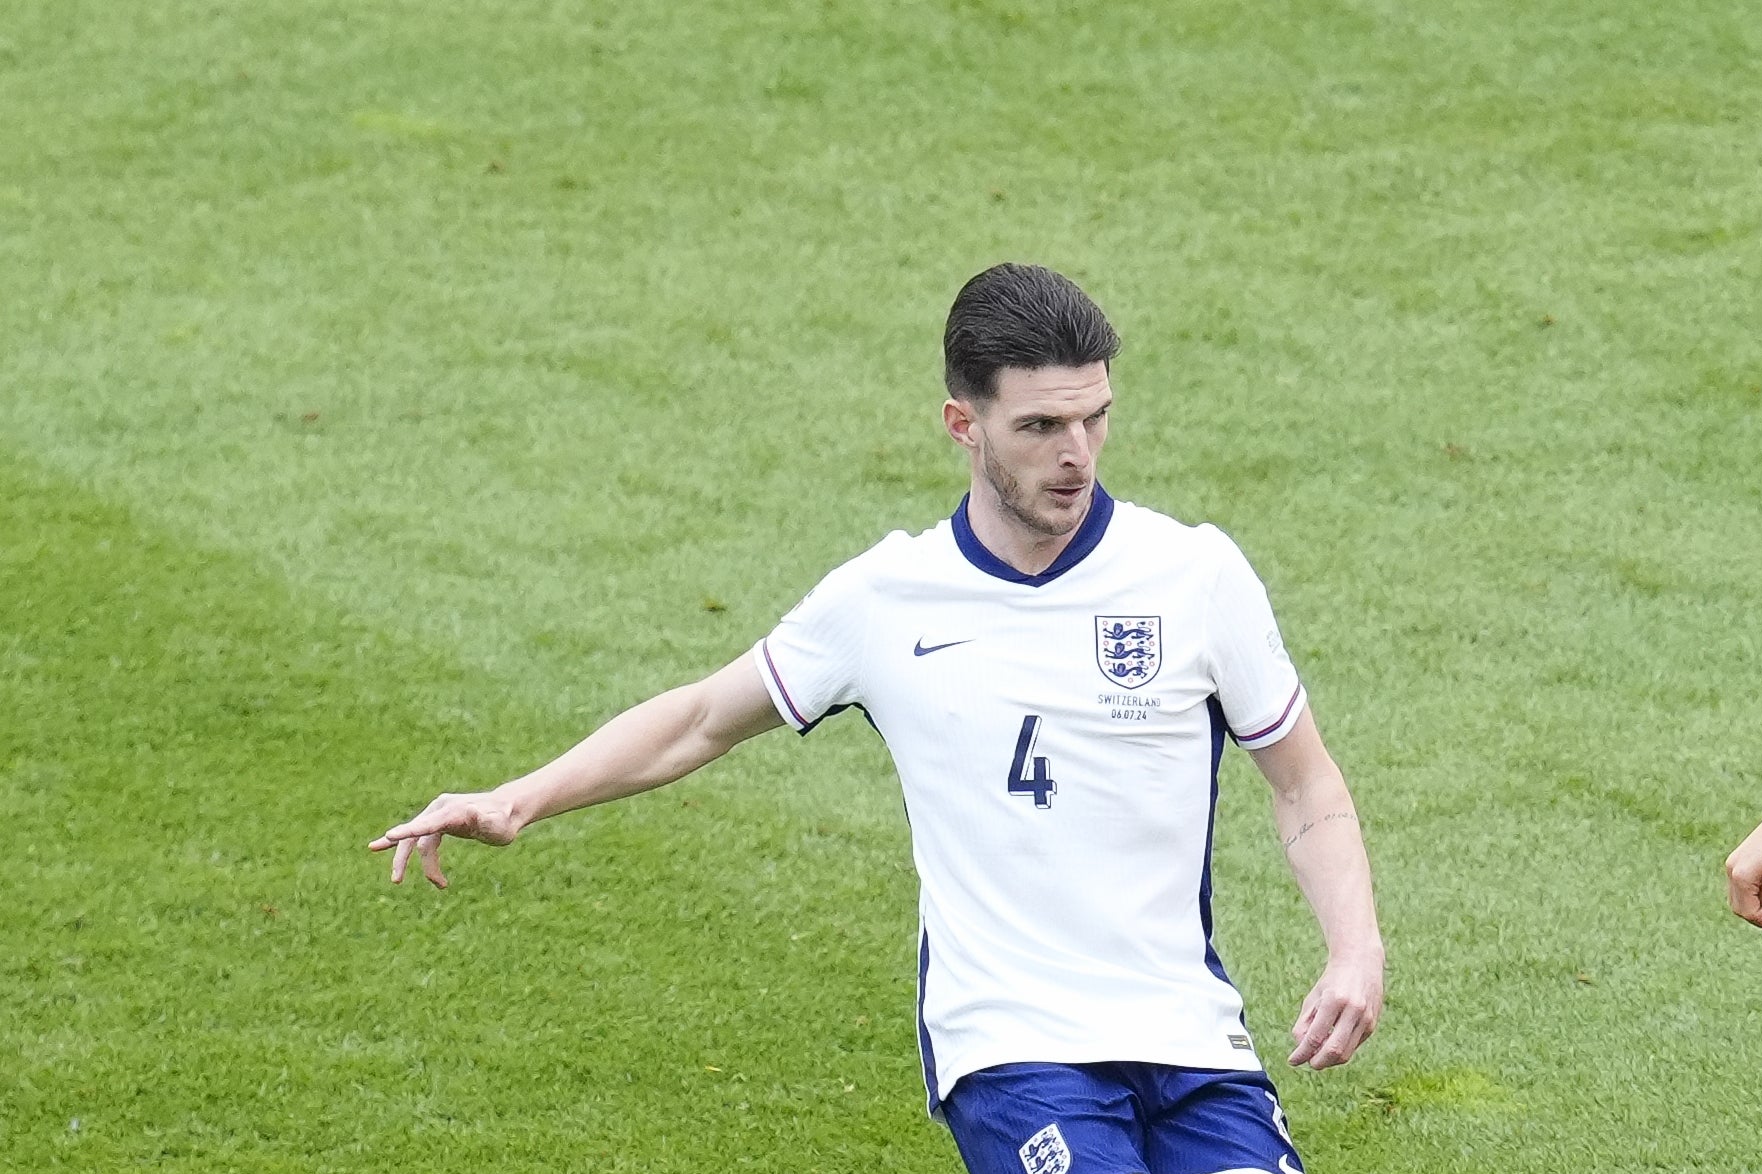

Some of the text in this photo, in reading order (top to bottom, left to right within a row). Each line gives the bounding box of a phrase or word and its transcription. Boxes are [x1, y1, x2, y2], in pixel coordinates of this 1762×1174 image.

[1098, 694, 1161, 707] SWITZERLAND
[1111, 708, 1147, 720] 06.07.24
[1007, 715, 1057, 809] 4
